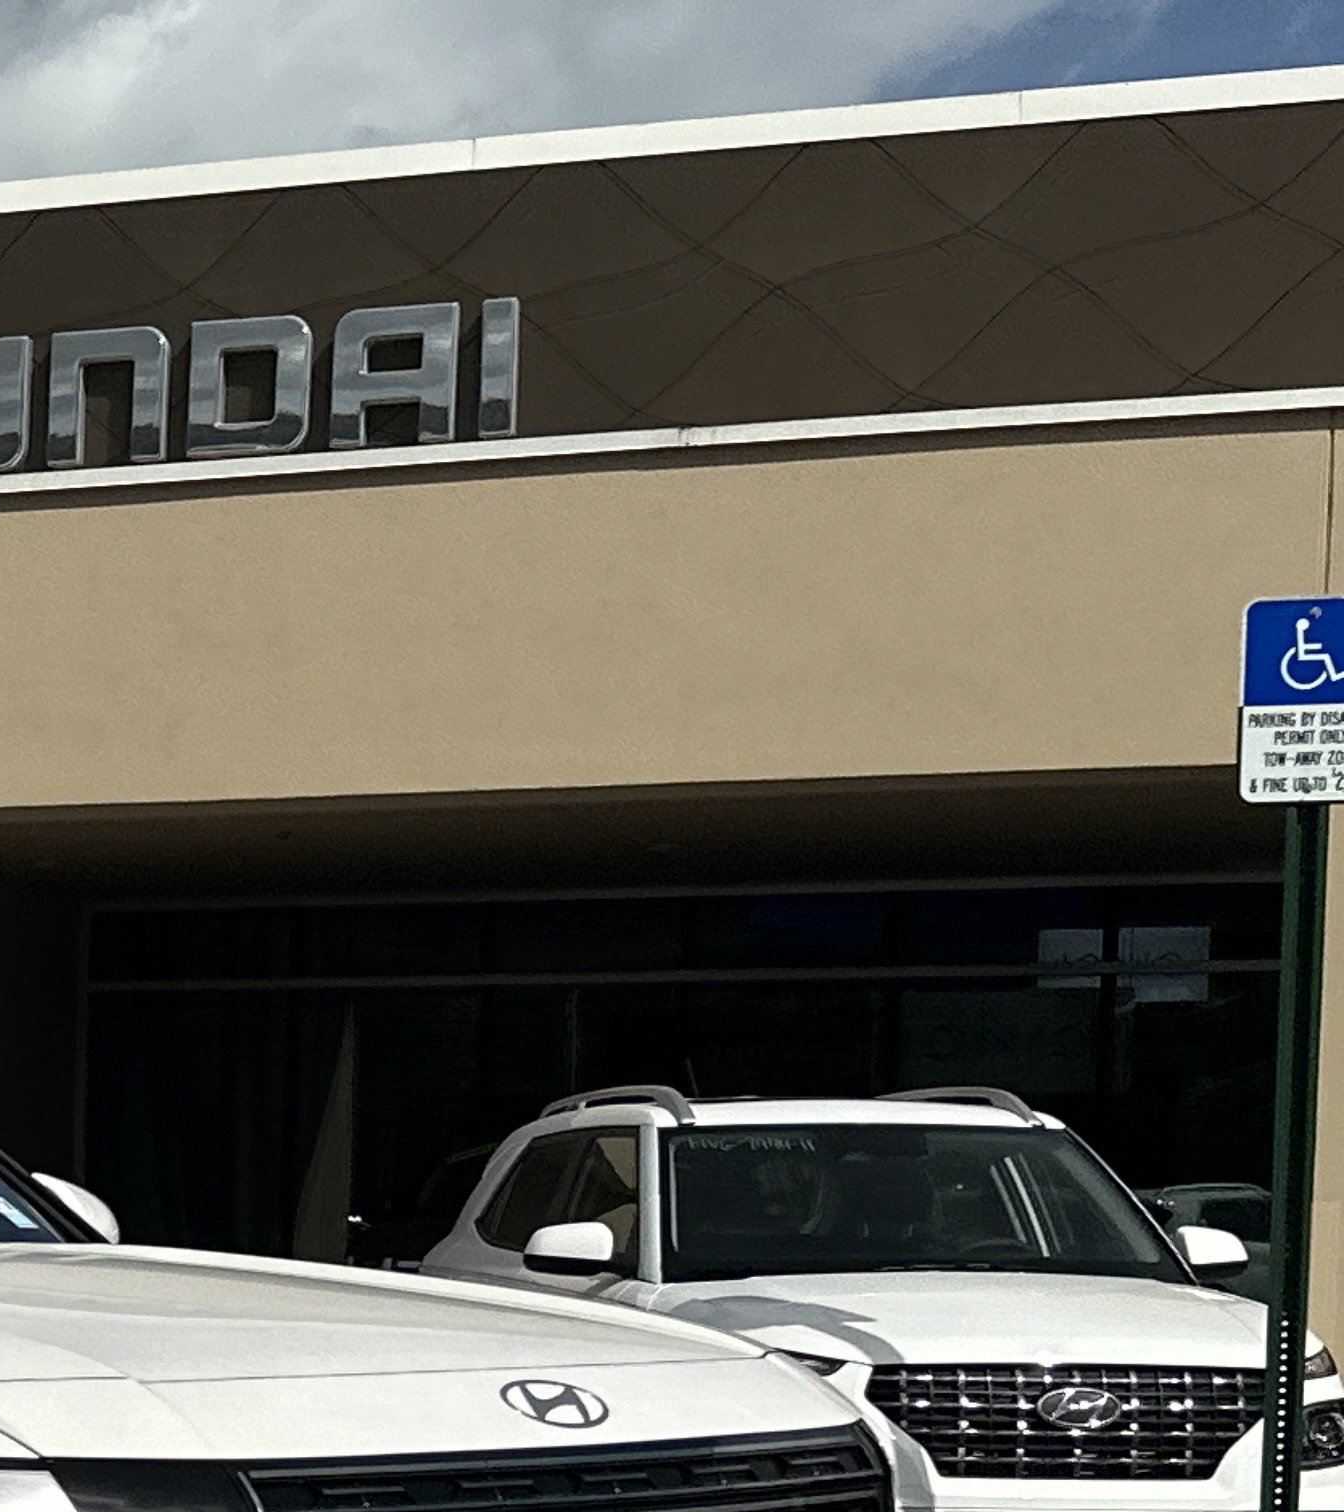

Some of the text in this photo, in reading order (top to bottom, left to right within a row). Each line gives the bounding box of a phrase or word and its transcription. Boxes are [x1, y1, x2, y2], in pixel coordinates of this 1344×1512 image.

[1248, 712, 1296, 728] PARKING
[1301, 711, 1315, 726] BY
[1274, 730, 1315, 745] PERMIT
[1264, 752, 1323, 767] TOW-AWAY
[1263, 777, 1288, 792] FINE
[1312, 776, 1326, 792] TO
